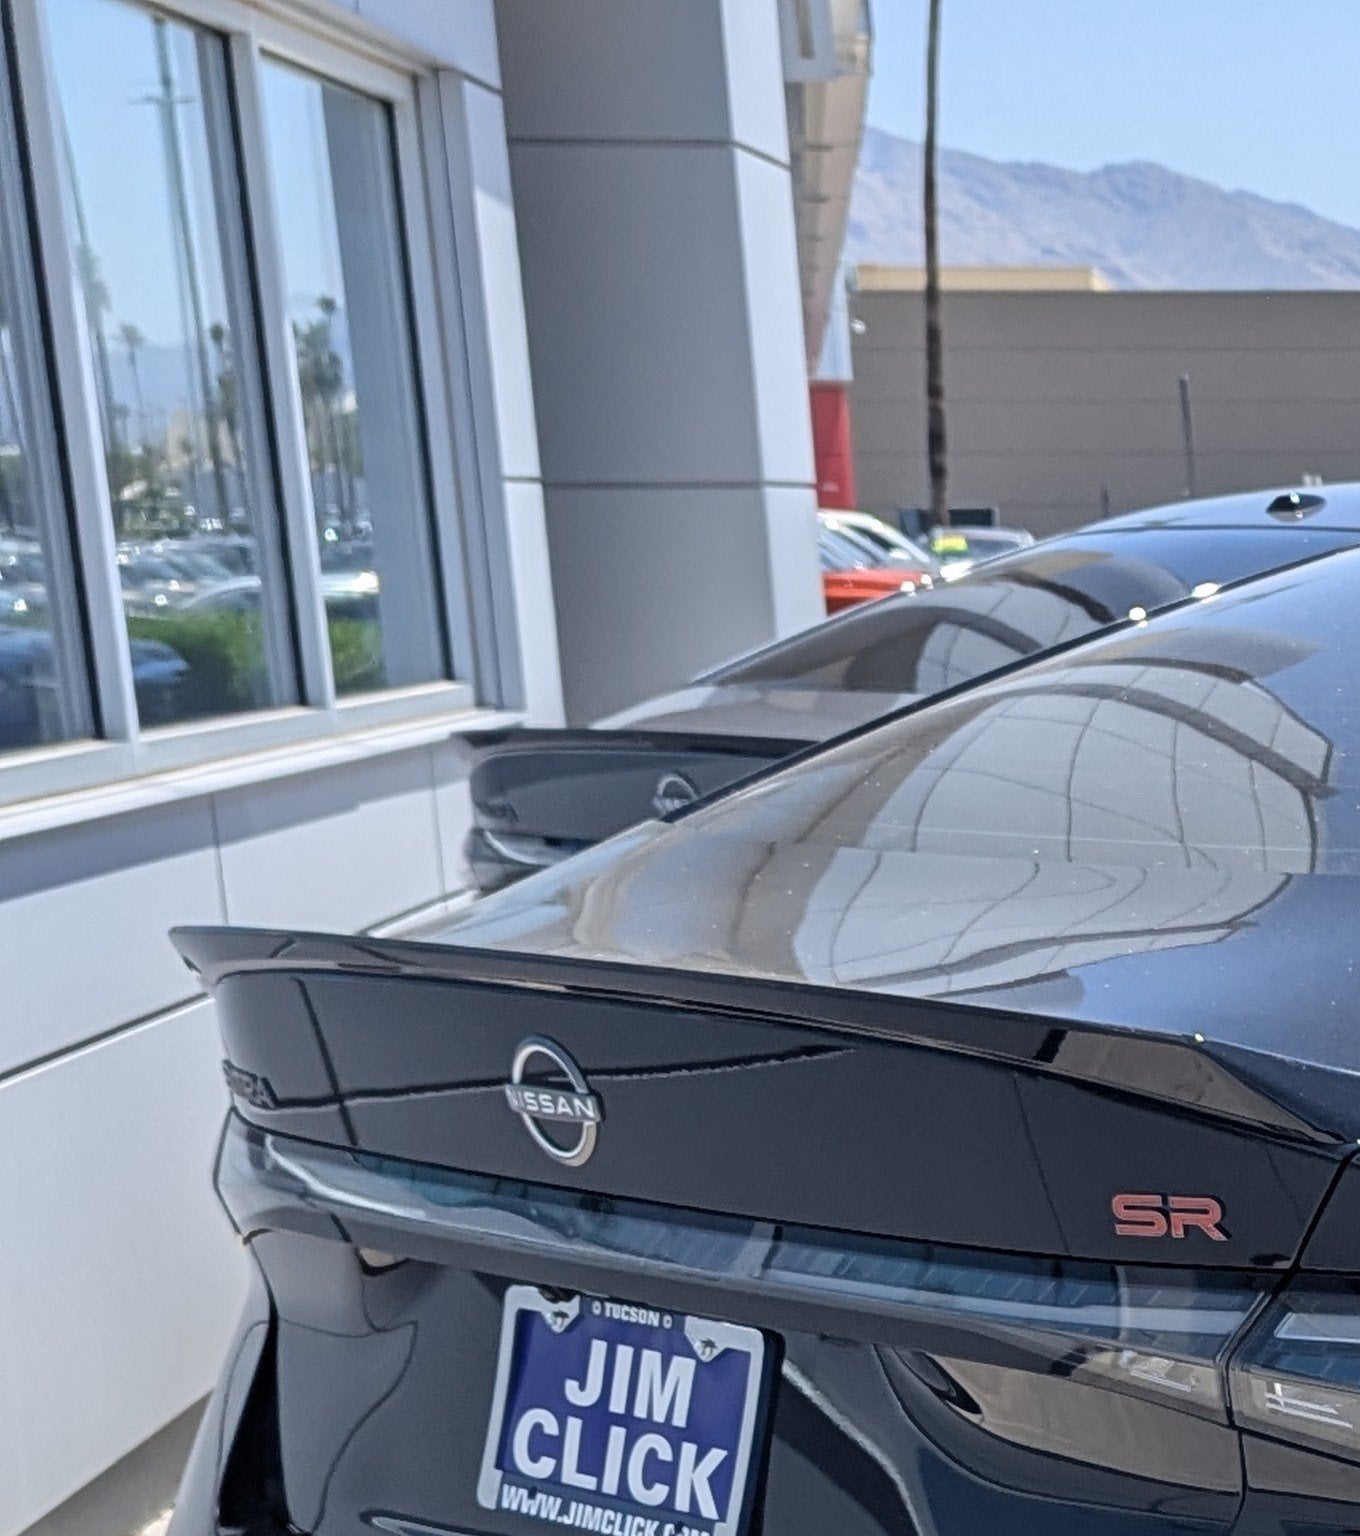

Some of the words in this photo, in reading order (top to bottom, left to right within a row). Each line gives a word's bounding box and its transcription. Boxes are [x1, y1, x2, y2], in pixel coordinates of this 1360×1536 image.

[506, 1086, 596, 1119] NISSAN
[1112, 1194, 1228, 1241] SR
[603, 1302, 661, 1328] TUCSON
[564, 1338, 697, 1428] JIM
[512, 1407, 729, 1521] CLICK
